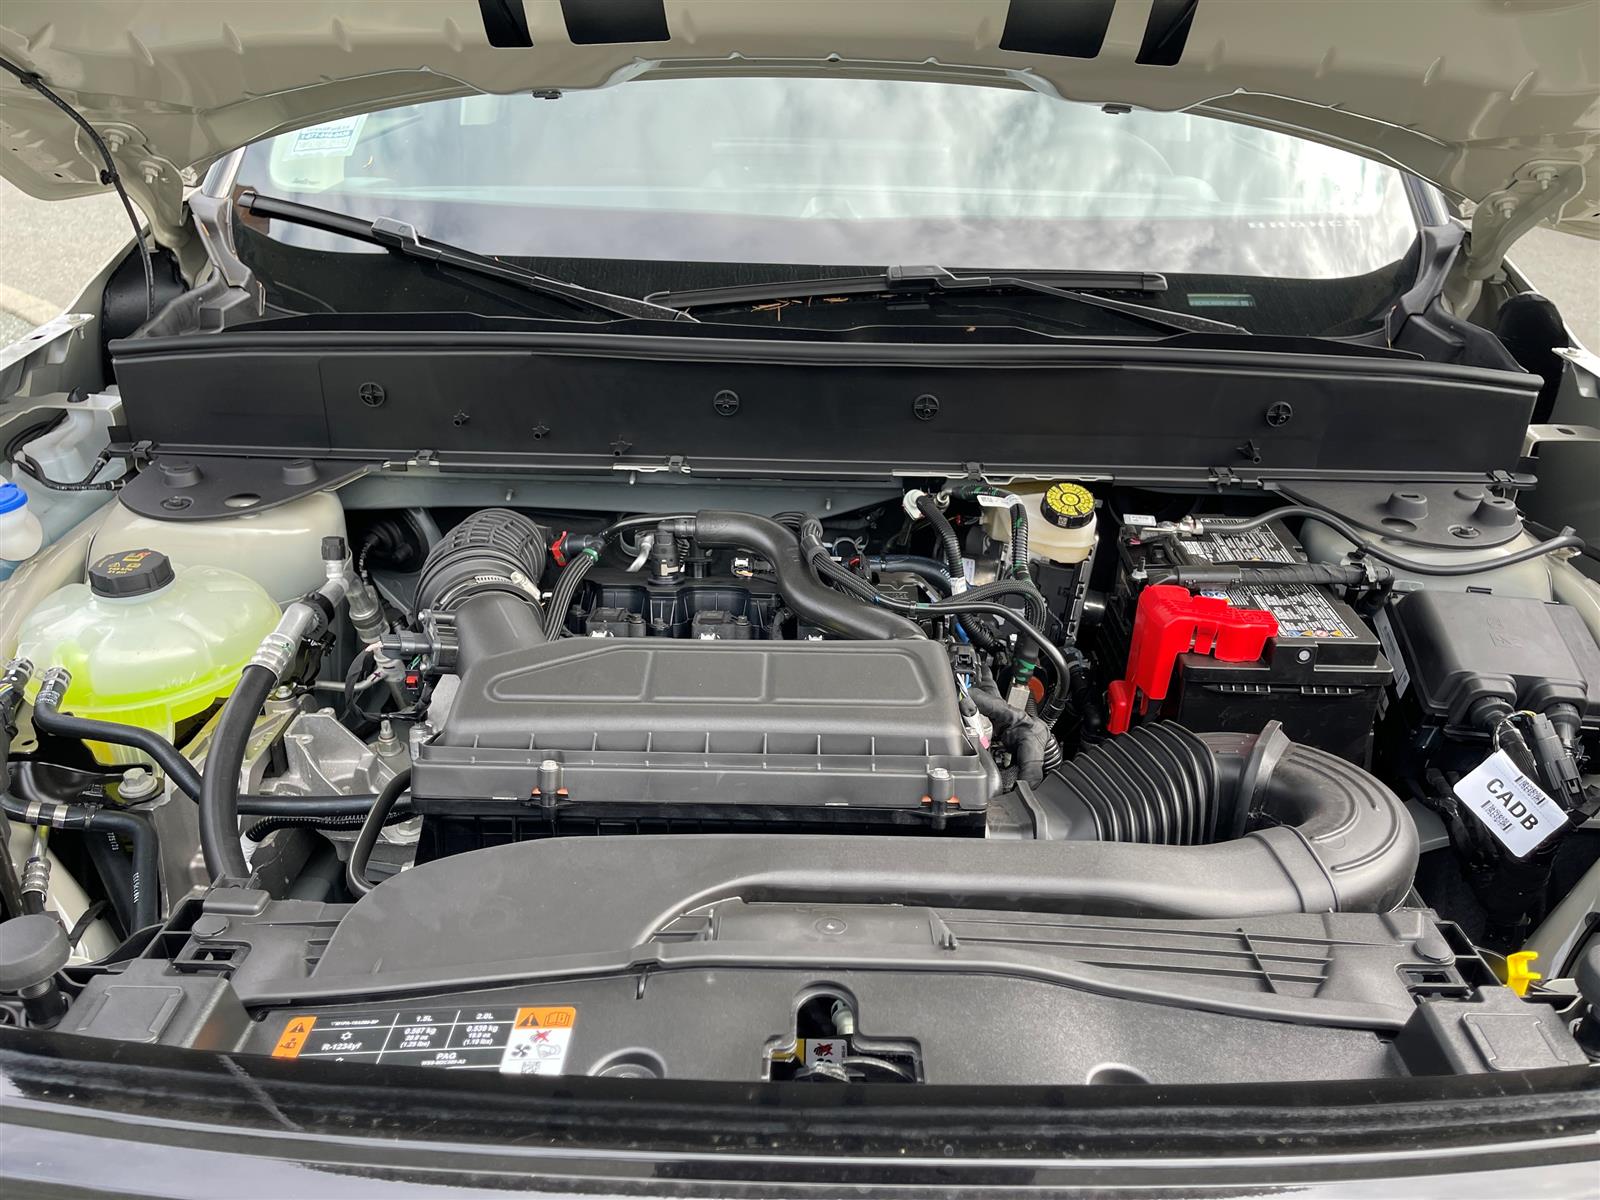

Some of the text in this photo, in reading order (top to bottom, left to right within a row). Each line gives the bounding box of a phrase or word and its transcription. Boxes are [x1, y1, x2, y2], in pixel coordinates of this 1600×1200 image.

[1486, 778, 1539, 831] CADB
[475, 1012, 494, 1021] 2.0L
[426, 1027, 437, 1035] kg
[488, 1024, 499, 1033] kg
[321, 1042, 363, 1051] R-1234yf
[436, 1052, 458, 1060] PAG
